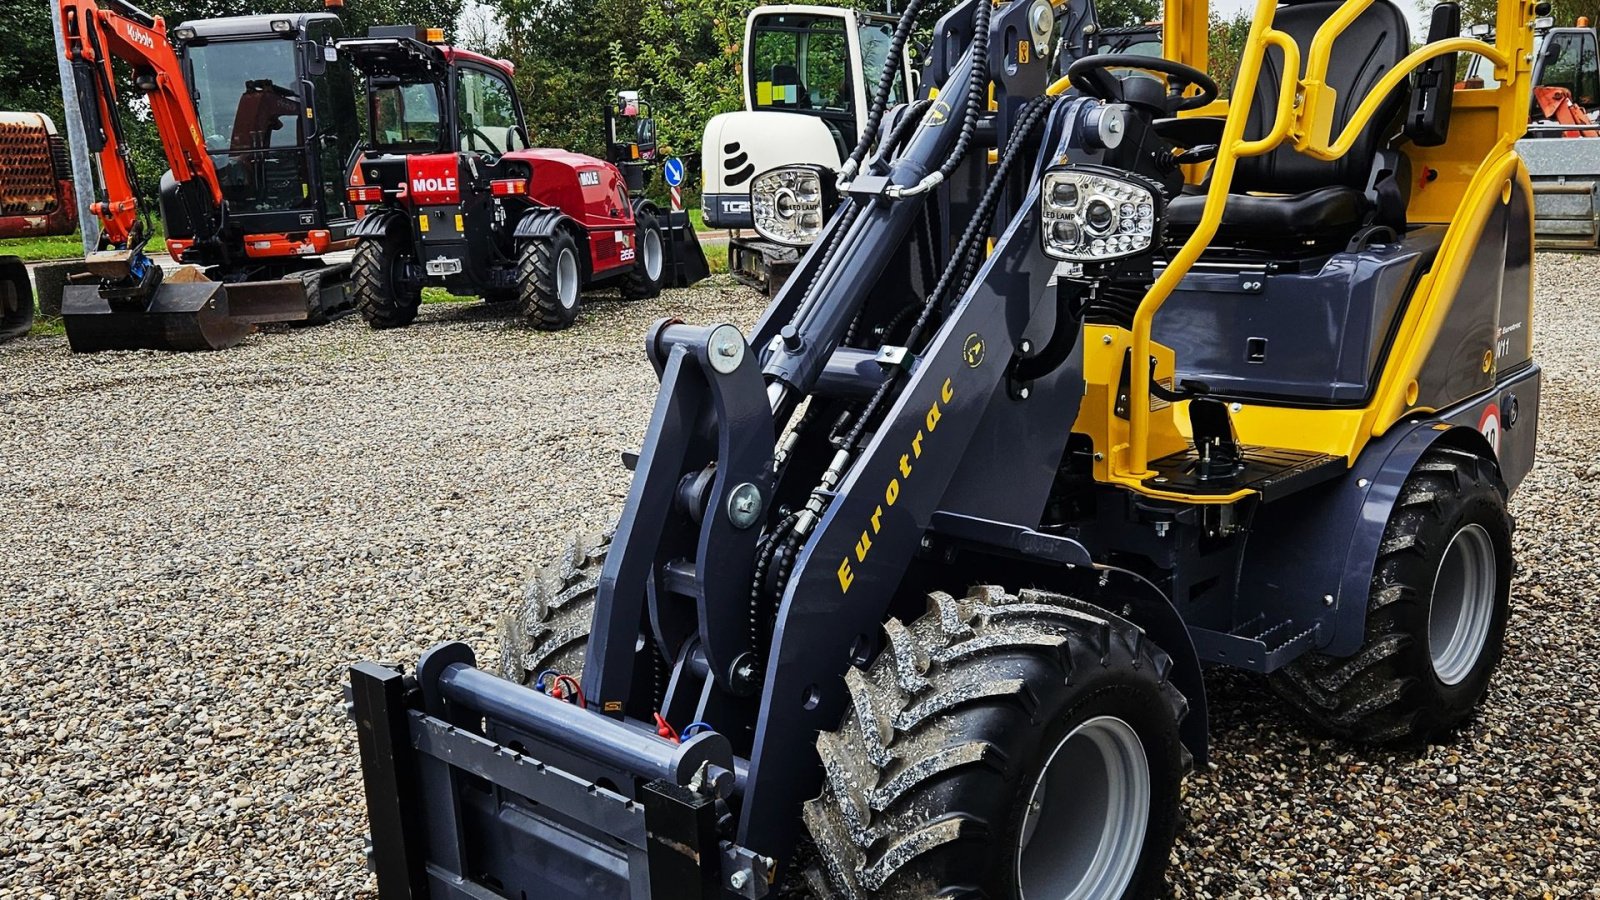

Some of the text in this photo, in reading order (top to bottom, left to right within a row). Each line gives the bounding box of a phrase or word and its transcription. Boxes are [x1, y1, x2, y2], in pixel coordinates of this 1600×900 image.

[127, 24, 154, 49] Kubota
[413, 177, 456, 192] MOLE
[580, 171, 599, 186] MOLE
[1043, 211, 1055, 219] LED
[837, 377, 954, 594] Eurotrac
